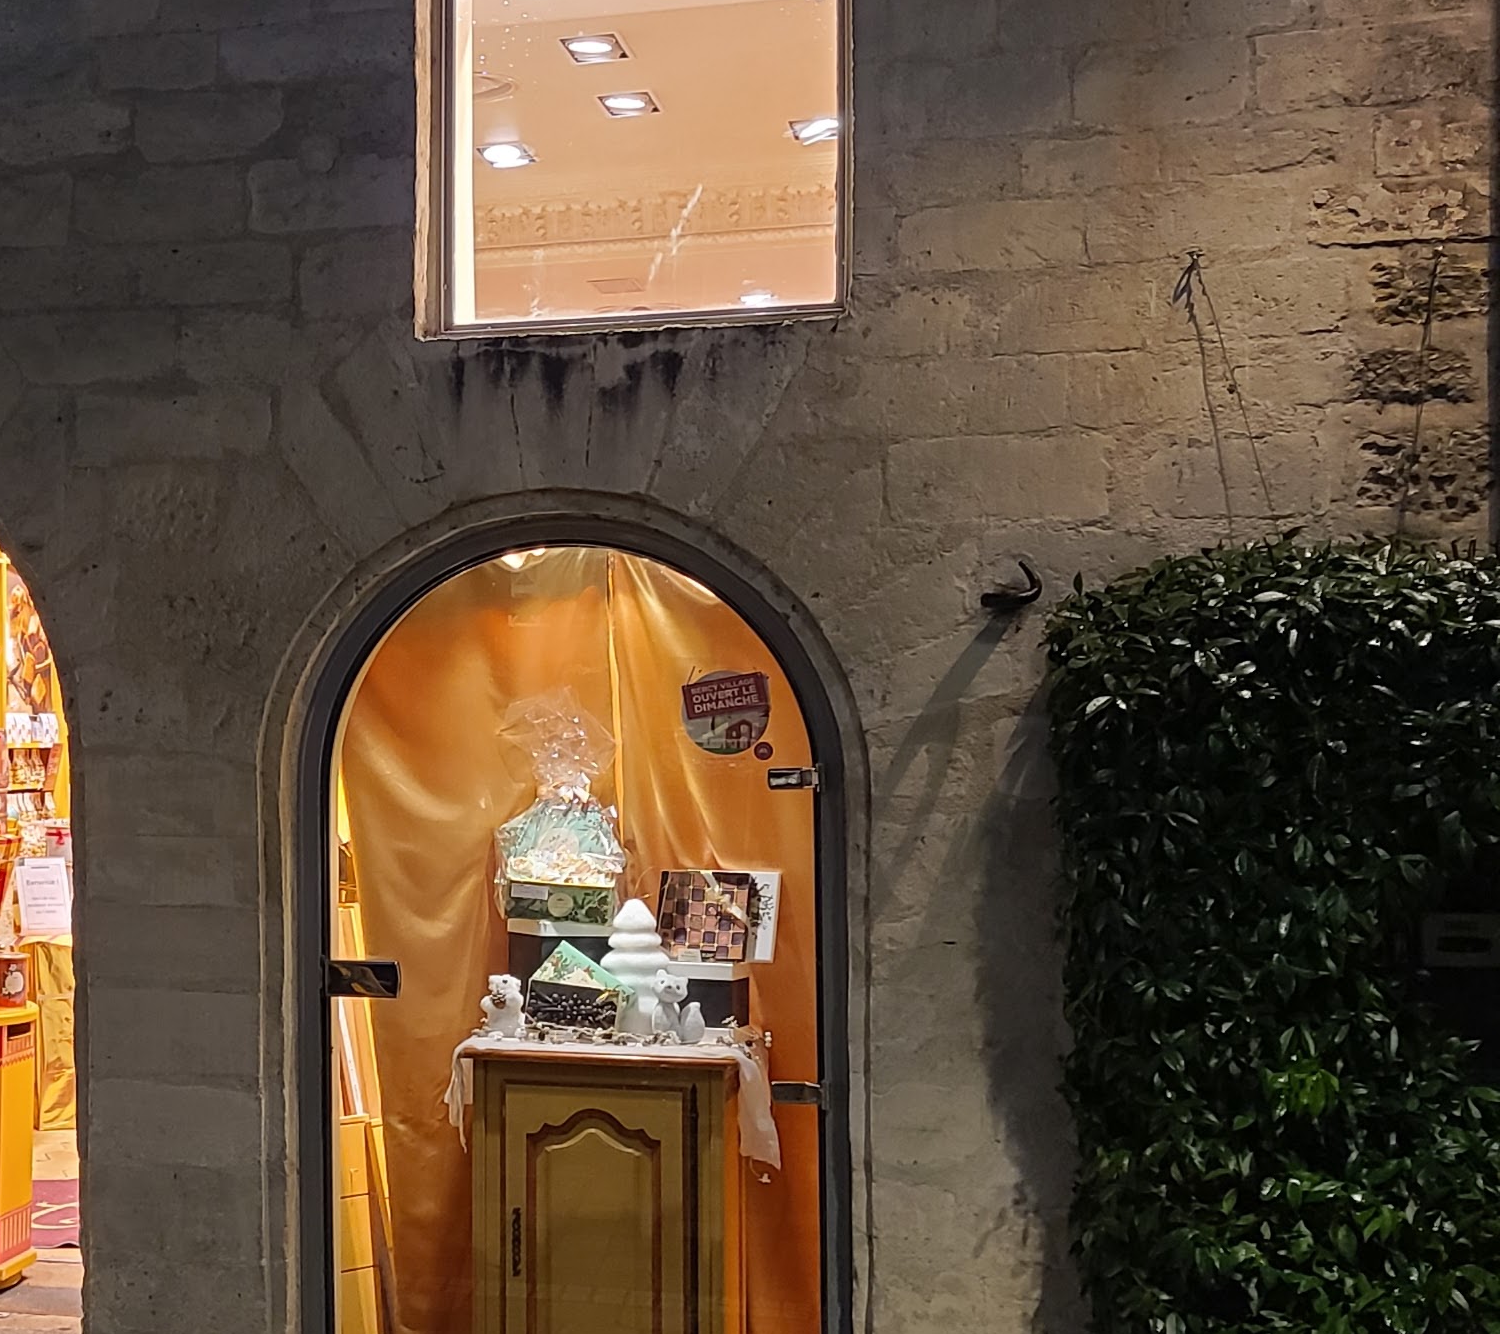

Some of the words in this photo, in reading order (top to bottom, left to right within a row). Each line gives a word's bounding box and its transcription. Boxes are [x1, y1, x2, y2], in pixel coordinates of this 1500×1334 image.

[719, 677, 756, 689] VILLAGE
[692, 688, 740, 704] OUVERT
[742, 685, 757, 695] LE
[693, 694, 759, 714] DIMANCHE
